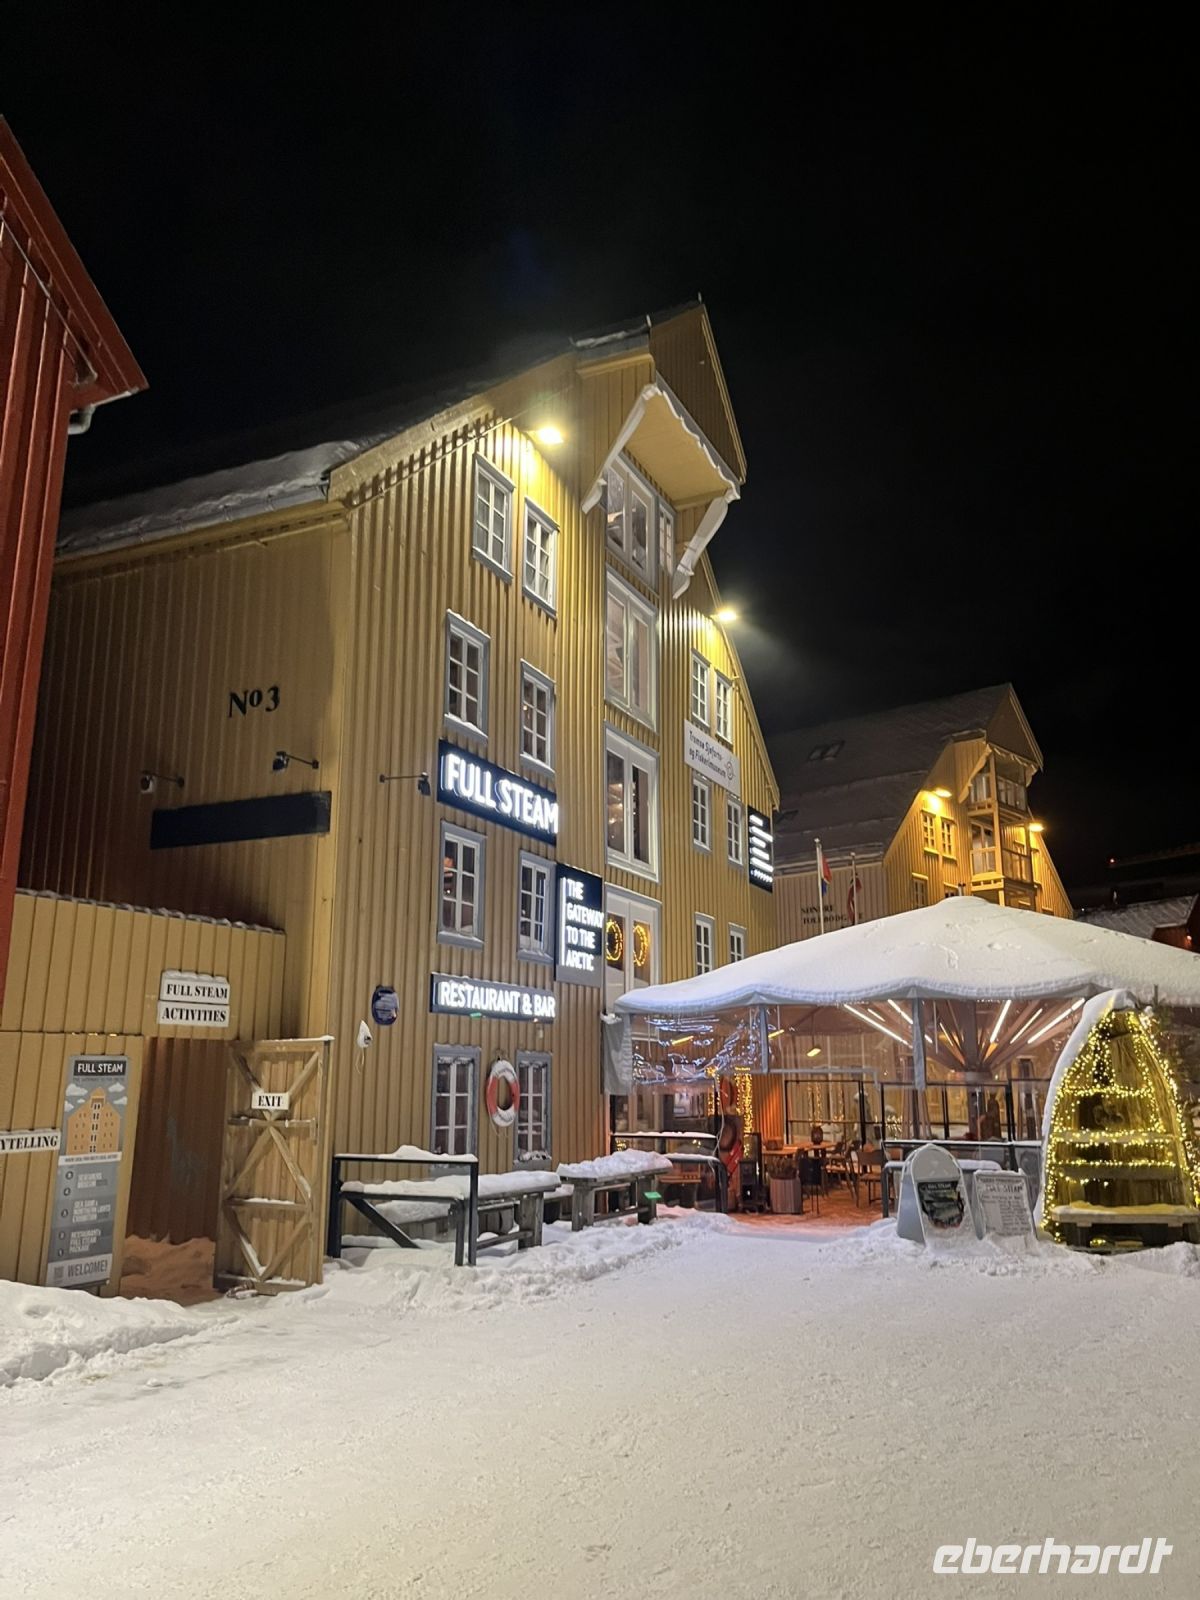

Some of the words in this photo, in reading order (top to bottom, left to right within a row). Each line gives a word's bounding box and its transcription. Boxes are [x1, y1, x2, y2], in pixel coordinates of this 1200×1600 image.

[446, 753, 496, 809] FULL
[499, 778, 559, 834] STEAM
[567, 878, 584, 900] THE
[567, 902, 605, 928] GATEWAY
[567, 925, 579, 945] TO
[579, 928, 596, 949] THE
[566, 949, 595, 972] ARCTIC
[166, 983, 193, 996] FULL
[194, 984, 228, 999] STEAM
[438, 981, 520, 1014] RESTAURANT
[522, 993, 532, 1015] &
[534, 994, 556, 1018] BAR
[161, 1007, 226, 1022] ACTIVITIES
[77, 1063, 96, 1073] FULL
[97, 1063, 123, 1073] STEAM
[258, 1095, 283, 1107] EXIT
[67, 1259, 108, 1278] WELCOME!
